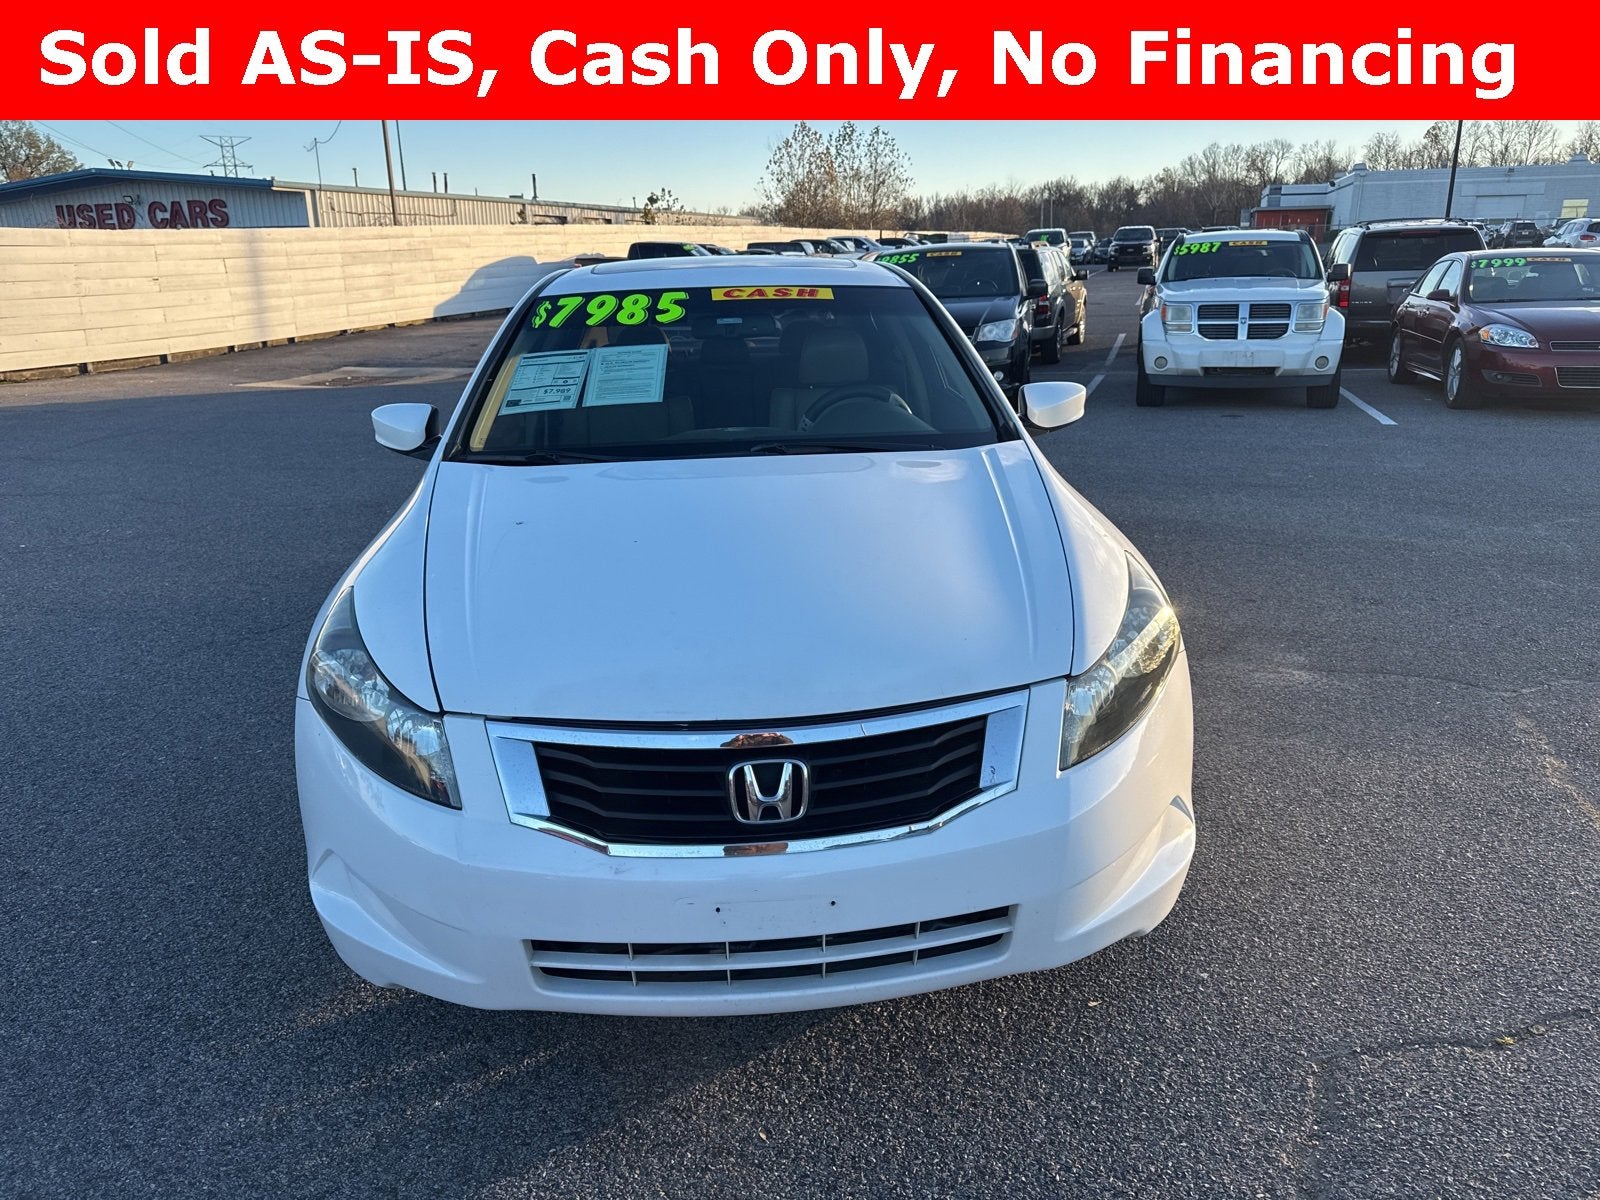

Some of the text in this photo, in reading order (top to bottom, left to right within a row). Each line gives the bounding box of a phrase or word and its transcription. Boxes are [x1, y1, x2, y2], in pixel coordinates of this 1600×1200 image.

[55, 198, 230, 230] USED CARS
[1173, 242, 1222, 256] $5987
[1470, 257, 1527, 269] $7999
[722, 288, 820, 299] CASH
[532, 291, 690, 329] $7985
